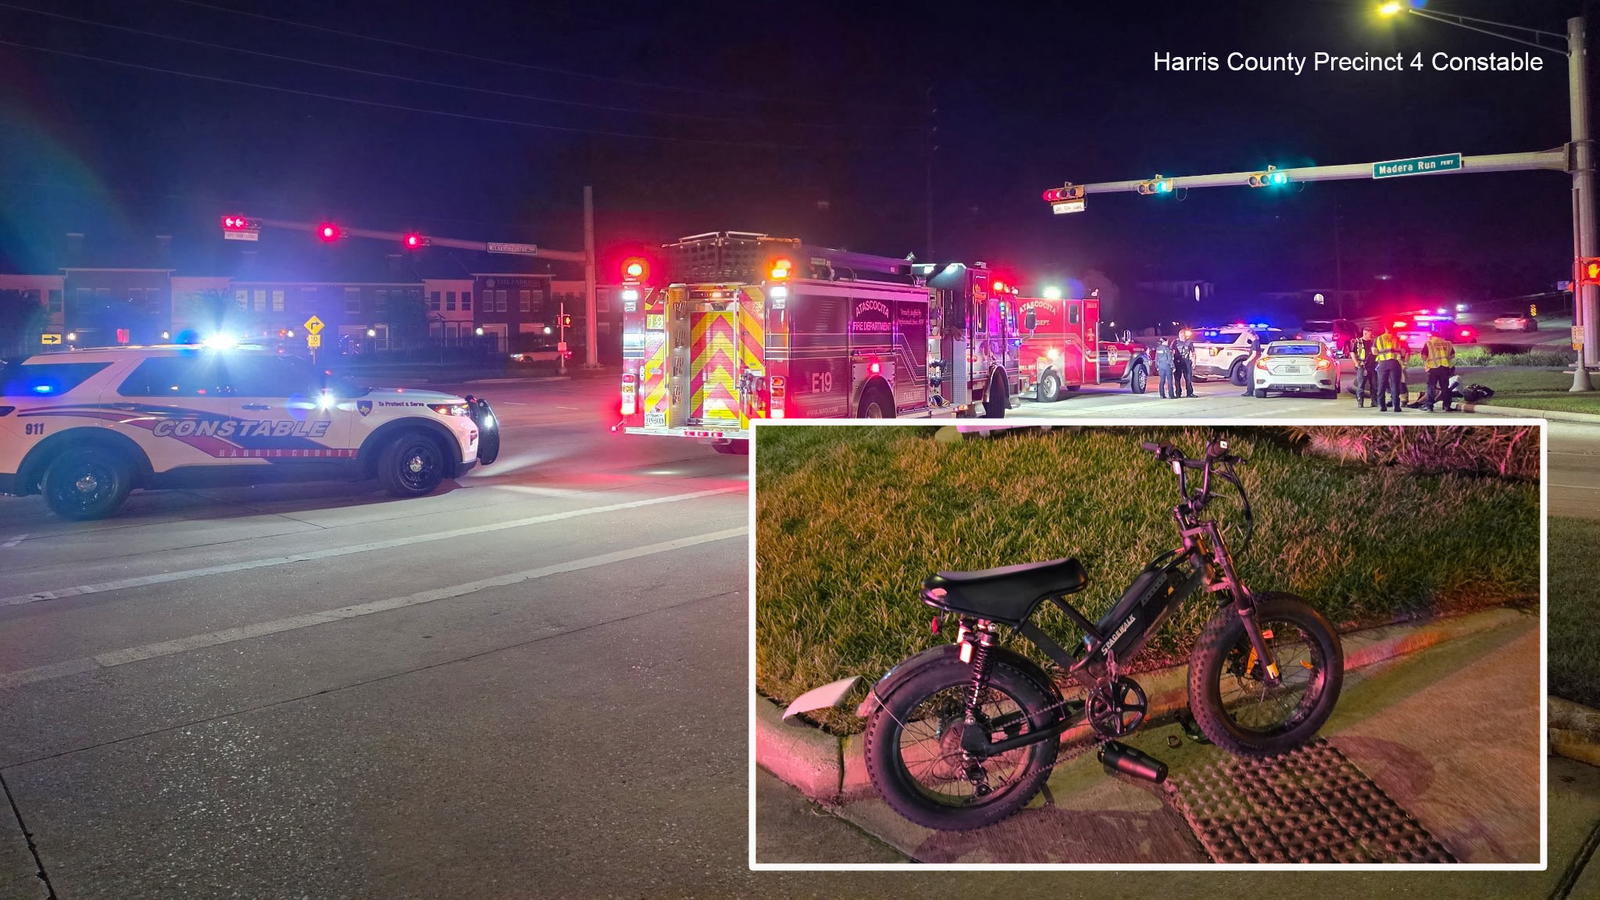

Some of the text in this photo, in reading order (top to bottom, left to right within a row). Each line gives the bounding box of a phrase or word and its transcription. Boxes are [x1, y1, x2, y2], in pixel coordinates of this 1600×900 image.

[1379, 165, 1413, 174] Madera
[1418, 161, 1436, 170] Run
[855, 300, 889, 318] ATASCOCITA
[1019, 300, 1056, 315] ATASCOCITA
[853, 322, 864, 330] FIRE
[864, 322, 891, 331] DEPARTMENT
[812, 371, 832, 393] E19
[25, 423, 44, 435] 911
[153, 420, 331, 437] CONSTABLE
[219, 449, 354, 457] HARRIS COUNTY
